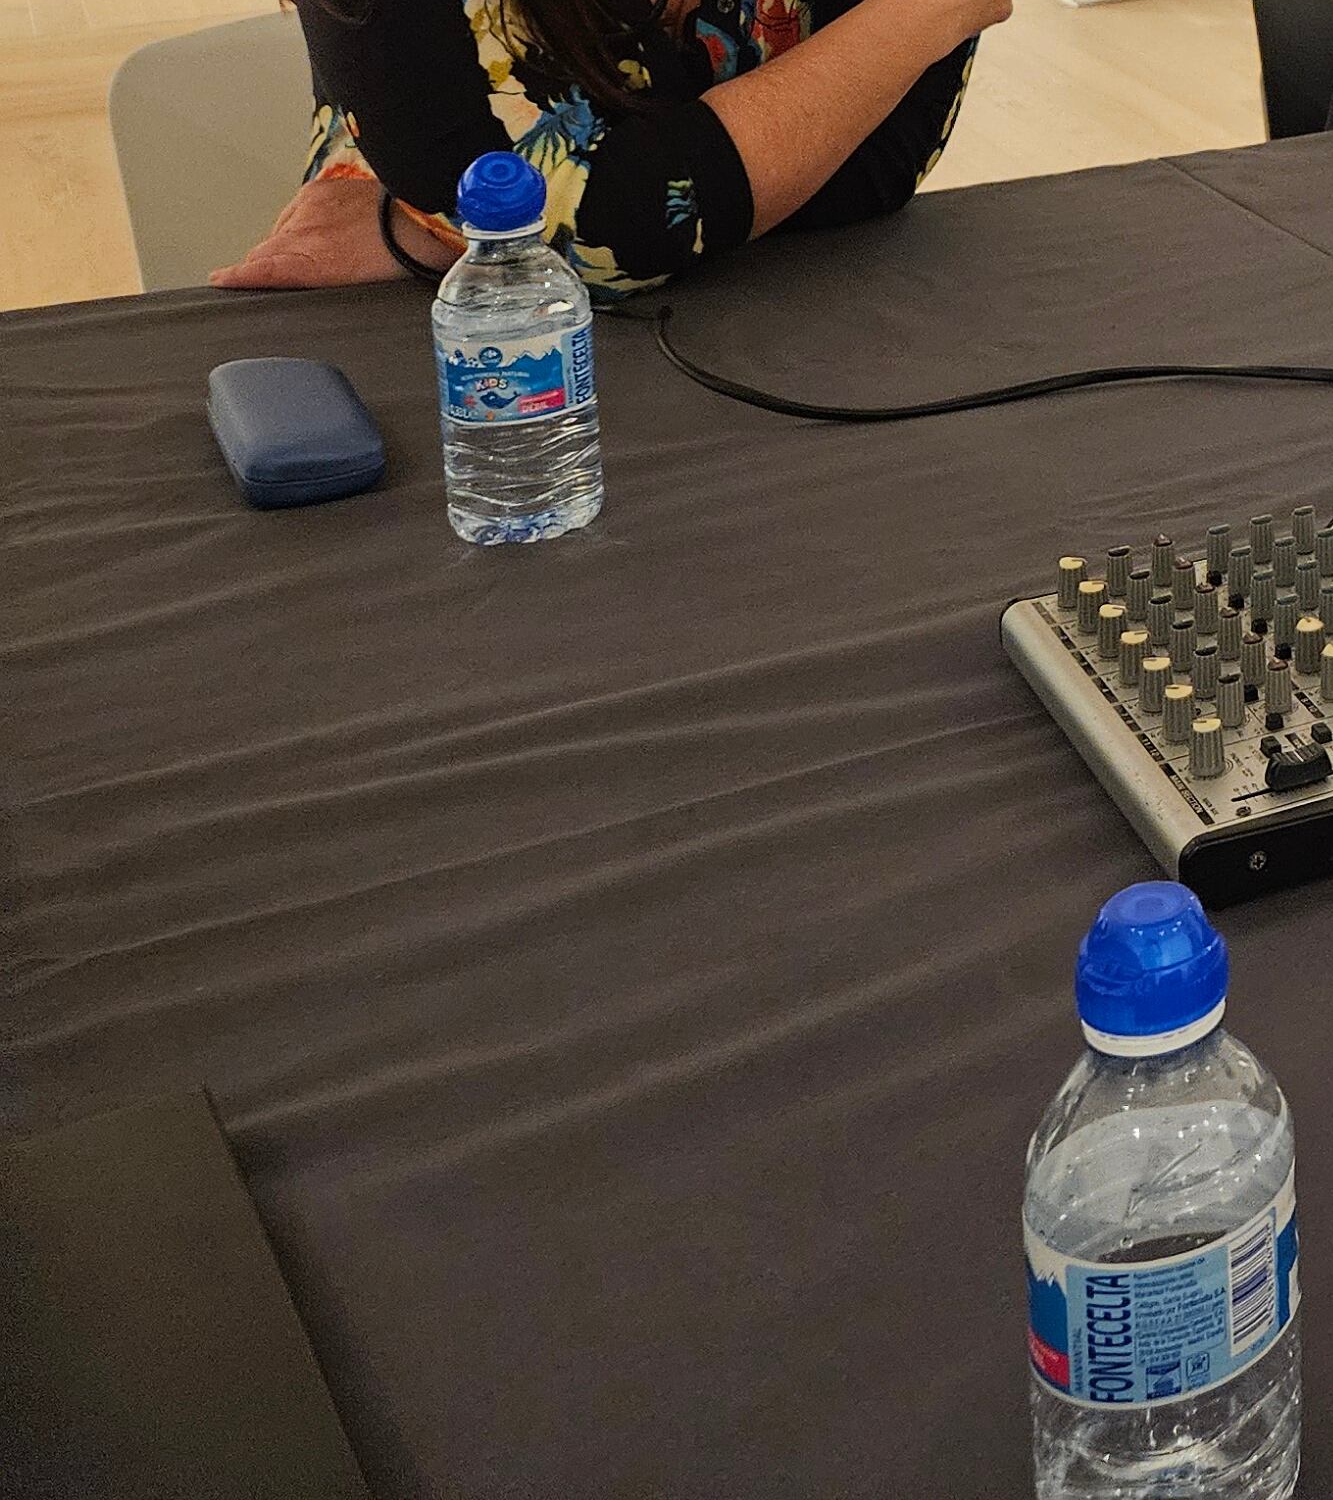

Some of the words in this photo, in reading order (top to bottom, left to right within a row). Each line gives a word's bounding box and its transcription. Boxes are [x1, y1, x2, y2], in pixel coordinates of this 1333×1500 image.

[474, 377, 508, 392] KIDS
[572, 328, 591, 404] FONTECELTA
[1086, 1273, 1134, 1403] FONTECELTA
